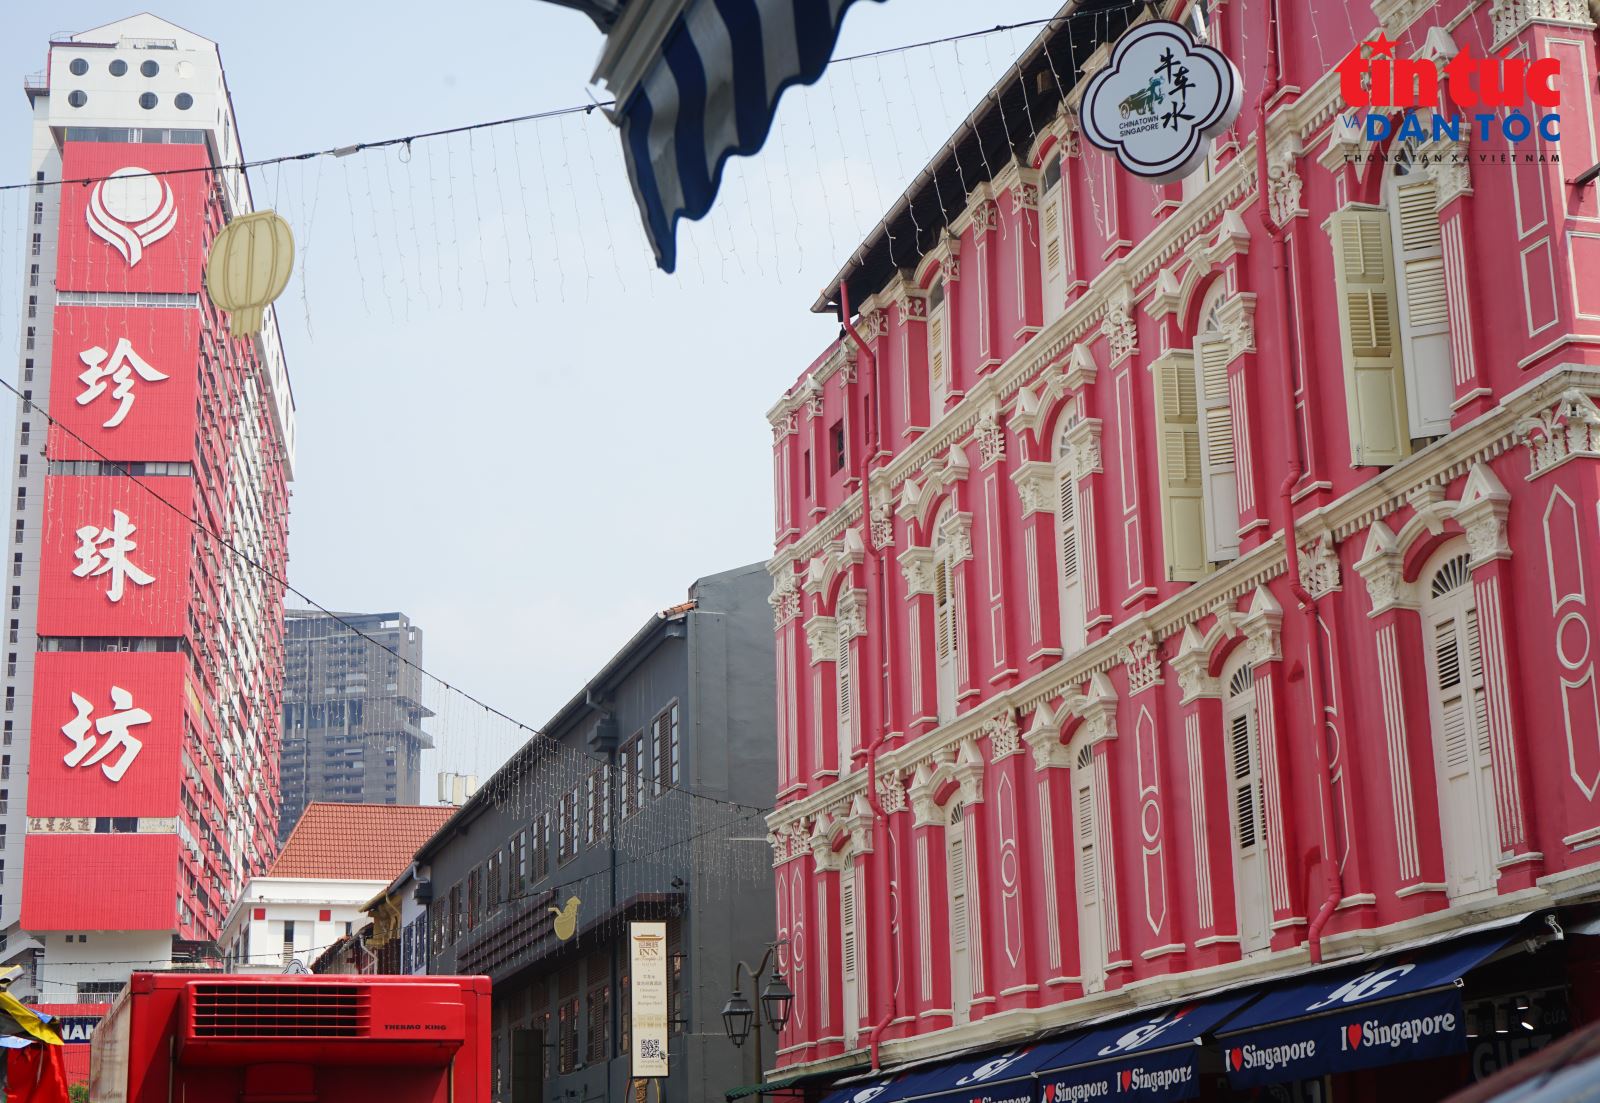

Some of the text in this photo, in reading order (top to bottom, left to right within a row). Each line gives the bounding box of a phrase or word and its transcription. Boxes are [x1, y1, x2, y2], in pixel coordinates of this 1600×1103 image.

[1154, 47, 1195, 131] 牛车水
[1119, 115, 1159, 129] CHINATOWN
[1120, 123, 1159, 137] SINGAPORE
[61, 337, 170, 783] 珍珠坊
[1341, 1012, 1456, 1051] I Singapore
[1225, 1039, 1316, 1073] I Singapore
[1055, 1079, 1108, 1103] Singapore
[1116, 1065, 1192, 1093] I Singapore
